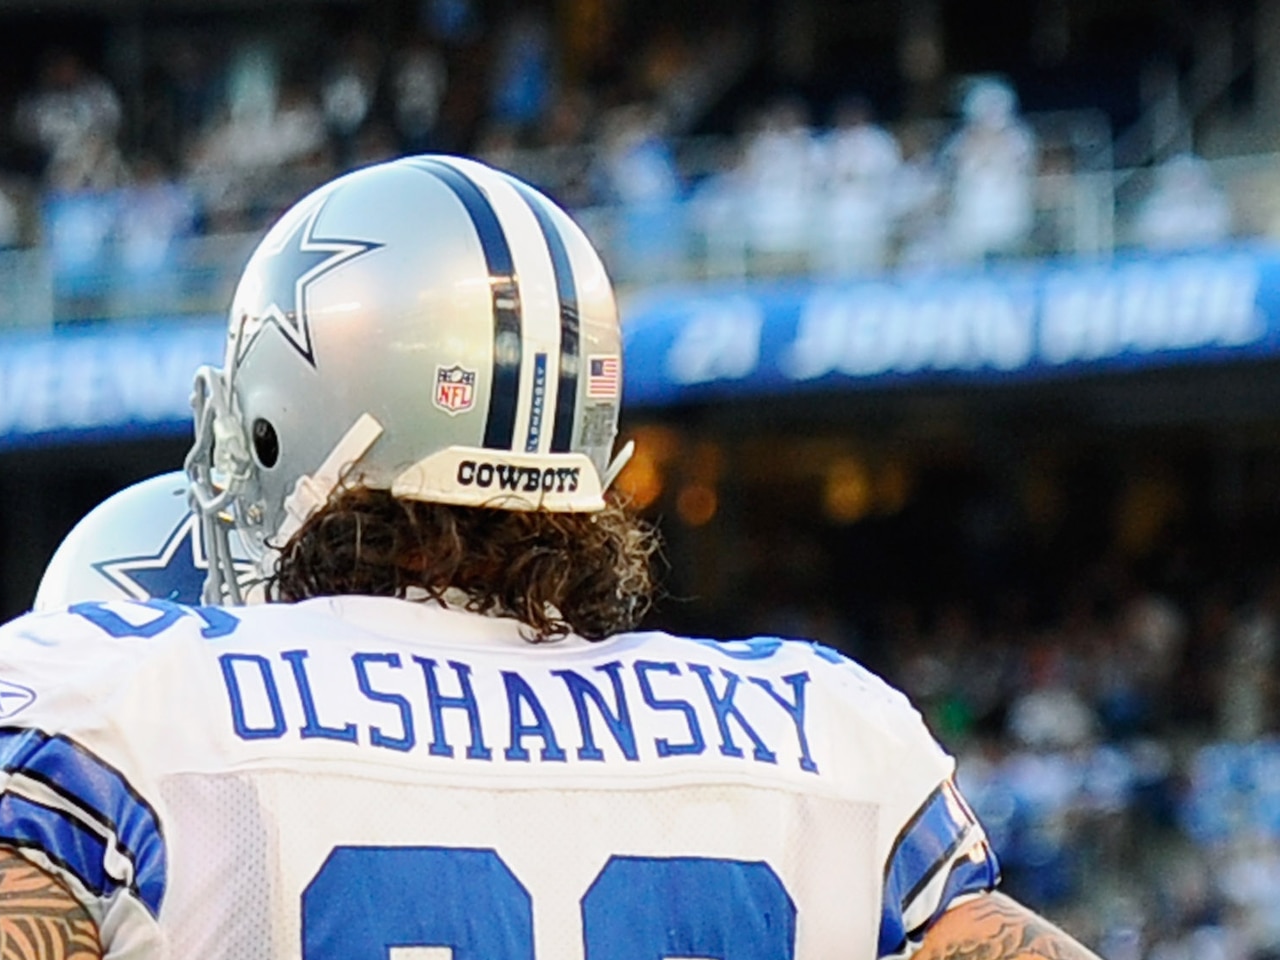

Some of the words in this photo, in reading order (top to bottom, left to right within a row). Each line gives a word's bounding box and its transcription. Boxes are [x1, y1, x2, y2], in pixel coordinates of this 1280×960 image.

[438, 384, 472, 409] NFL
[457, 461, 581, 492] COWBOYS
[218, 649, 821, 775] OLSHANSKY
